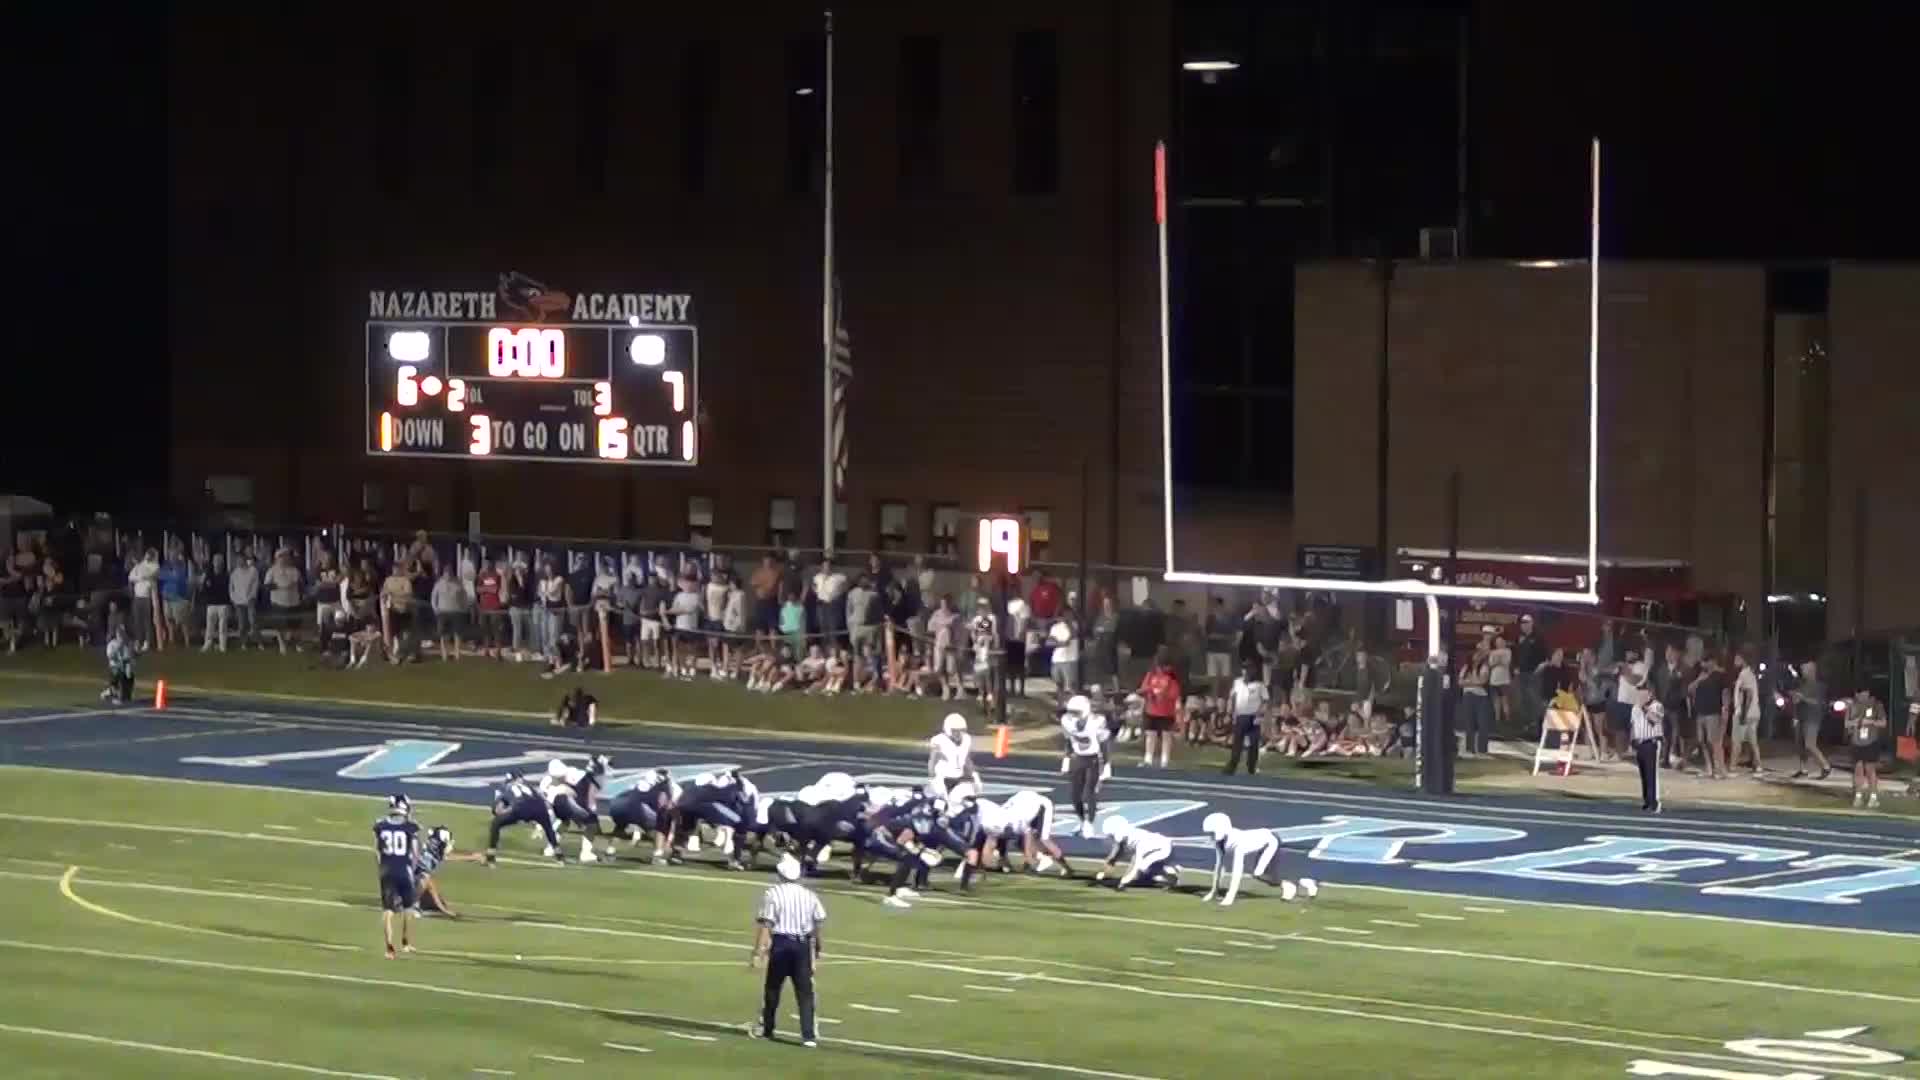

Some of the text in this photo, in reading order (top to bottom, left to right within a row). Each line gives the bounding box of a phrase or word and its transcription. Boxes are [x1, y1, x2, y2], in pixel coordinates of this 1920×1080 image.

[369, 291, 692, 321] NAZARETH ACADEMY
[488, 328, 565, 377] 0:00
[397, 366, 418, 406] 6
[447, 379, 465, 412] 2
[593, 382, 612, 415] 3
[662, 371, 684, 412] 7
[392, 418, 444, 447] DOWN
[469, 414, 491, 455] 3
[492, 420, 585, 451] TO GO ON
[633, 424, 669, 457] QTR
[979, 518, 1020, 574] 19
[379, 830, 408, 856] 30
